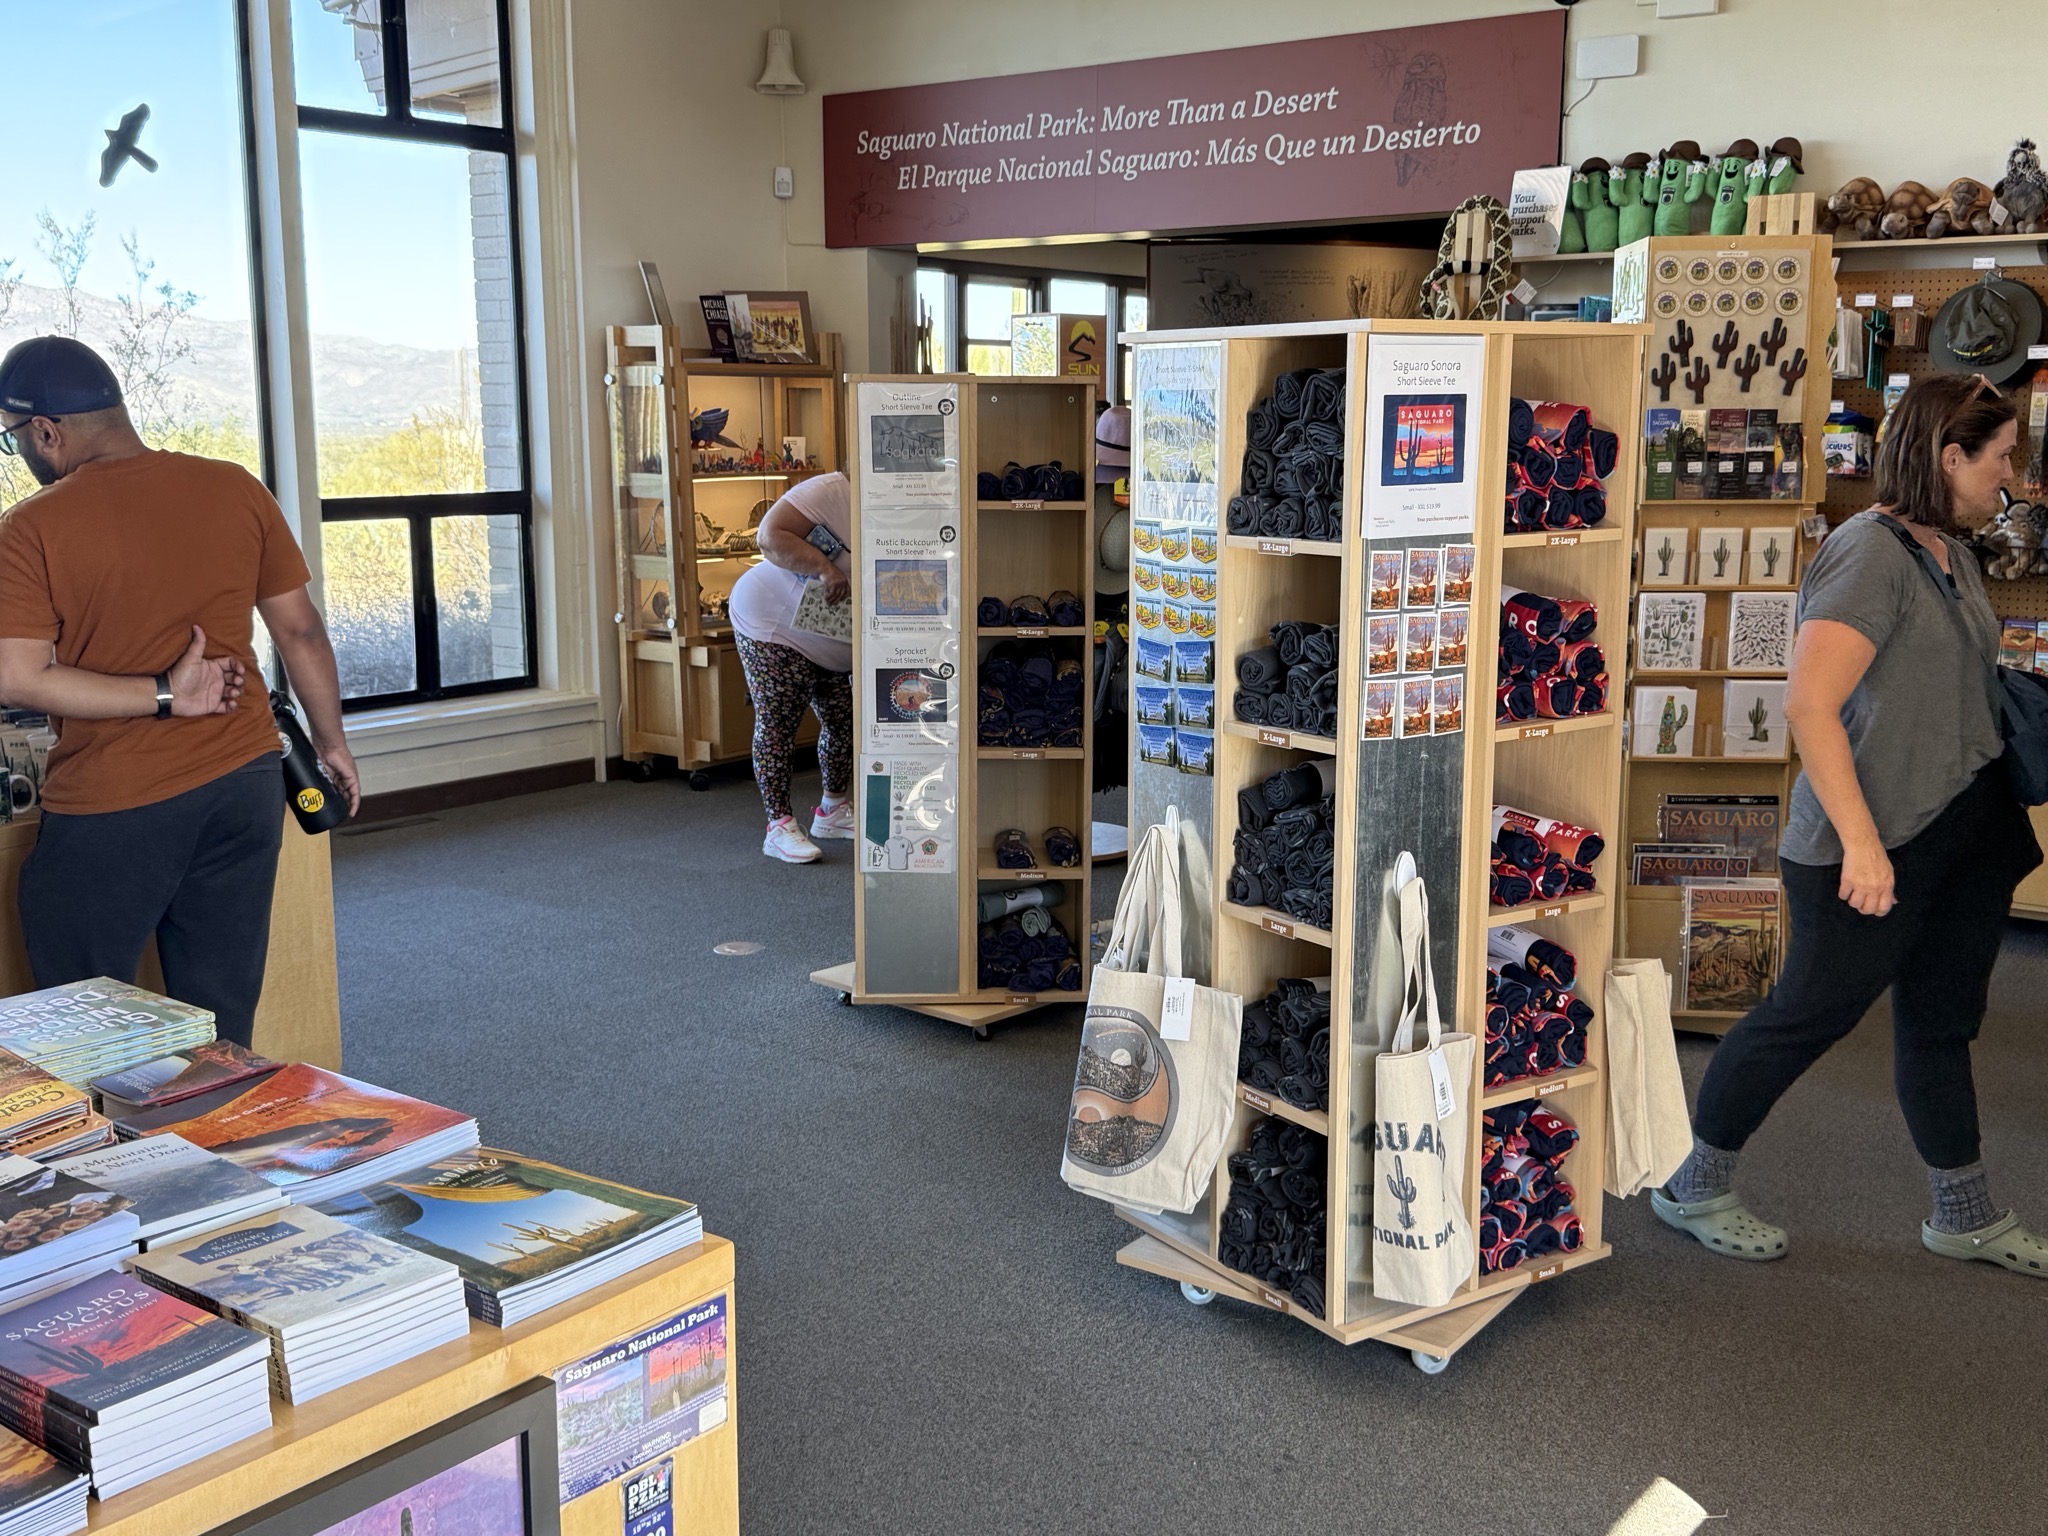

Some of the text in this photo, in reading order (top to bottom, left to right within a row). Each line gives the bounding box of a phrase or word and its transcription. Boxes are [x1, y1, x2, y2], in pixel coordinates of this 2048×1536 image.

[857, 86, 1338, 160] Saguaro National Park: More Than a Desert
[898, 120, 1481, 193] El Parque Nacional Saguaro: Más Que un Desierto
[1514, 194, 1536, 203] Your
[1512, 204, 1558, 217] purchases
[1510, 214, 1546, 227] support
[703, 300, 725, 309] MICHAEL
[705, 310, 729, 320] CHIAGO
[1068, 363, 1100, 376] SUN
[1393, 360, 1461, 372] Saguaro Sonora
[1397, 376, 1456, 386] Short Sleeve Tee
[893, 393, 921, 401] Outline
[881, 403, 898, 411] Short
[900, 403, 920, 411] Sleeve
[1401, 409, 1452, 419] SAGUARO
[900, 539, 946, 548] Backcountry
[1551, 536, 1578, 546] 2X-Large
[1262, 543, 1289, 554] 2X-Large
[895, 648, 927, 657] Sprocket
[1263, 734, 1285, 743] X-Large
[1525, 728, 1548, 738] X-Large
[300, 793, 322, 809] Buff
[1670, 810, 1775, 827] SAGUARO
[1549, 825, 1580, 839] PARK
[1642, 858, 1725, 870] SAGUARO
[1694, 891, 1776, 904] SAGUARO
[1544, 907, 1561, 917] Large
[1270, 921, 1287, 933] Large
[59, 1003, 93, 1014] in
[1106, 1009, 1133, 1019] PARK
[9, 1006, 130, 1036] Who's
[31, 1012, 158, 1043] Guess
[18, 1089, 38, 1100] the
[1539, 1083, 1565, 1096] Medium
[257, 1097, 301, 1115] National
[1245, 1092, 1269, 1109] Medium
[219, 1115, 241, 1123] The
[242, 1102, 274, 1116] Guide
[83, 1143, 169, 1167] Mountains
[105, 1146, 191, 1170] Next Door
[1112, 1157, 1149, 1175] ARIZONA
[200, 1241, 261, 1261] NATIONAL
[262, 1230, 293, 1242] PARK
[211, 1233, 266, 1252] SAGUARO
[1539, 1267, 1556, 1279] Small
[1265, 1292, 1281, 1308] Small
[5, 1289, 126, 1341] SAGUARO
[44, 1291, 149, 1338] CACTUS
[69, 1318, 117, 1339] NATURAL
[118, 1298, 158, 1320] HISTORY
[565, 1304, 719, 1384] Saguaro National Park
[24, 1381, 46, 1398] CACTUS
[87, 1388, 113, 1400] DAVID
[94, 1391, 118, 1402] KEVIN
[641, 1431, 672, 1451] WARNING:
[628, 1474, 658, 1498] DBL
[628, 1488, 658, 1512] PZL
